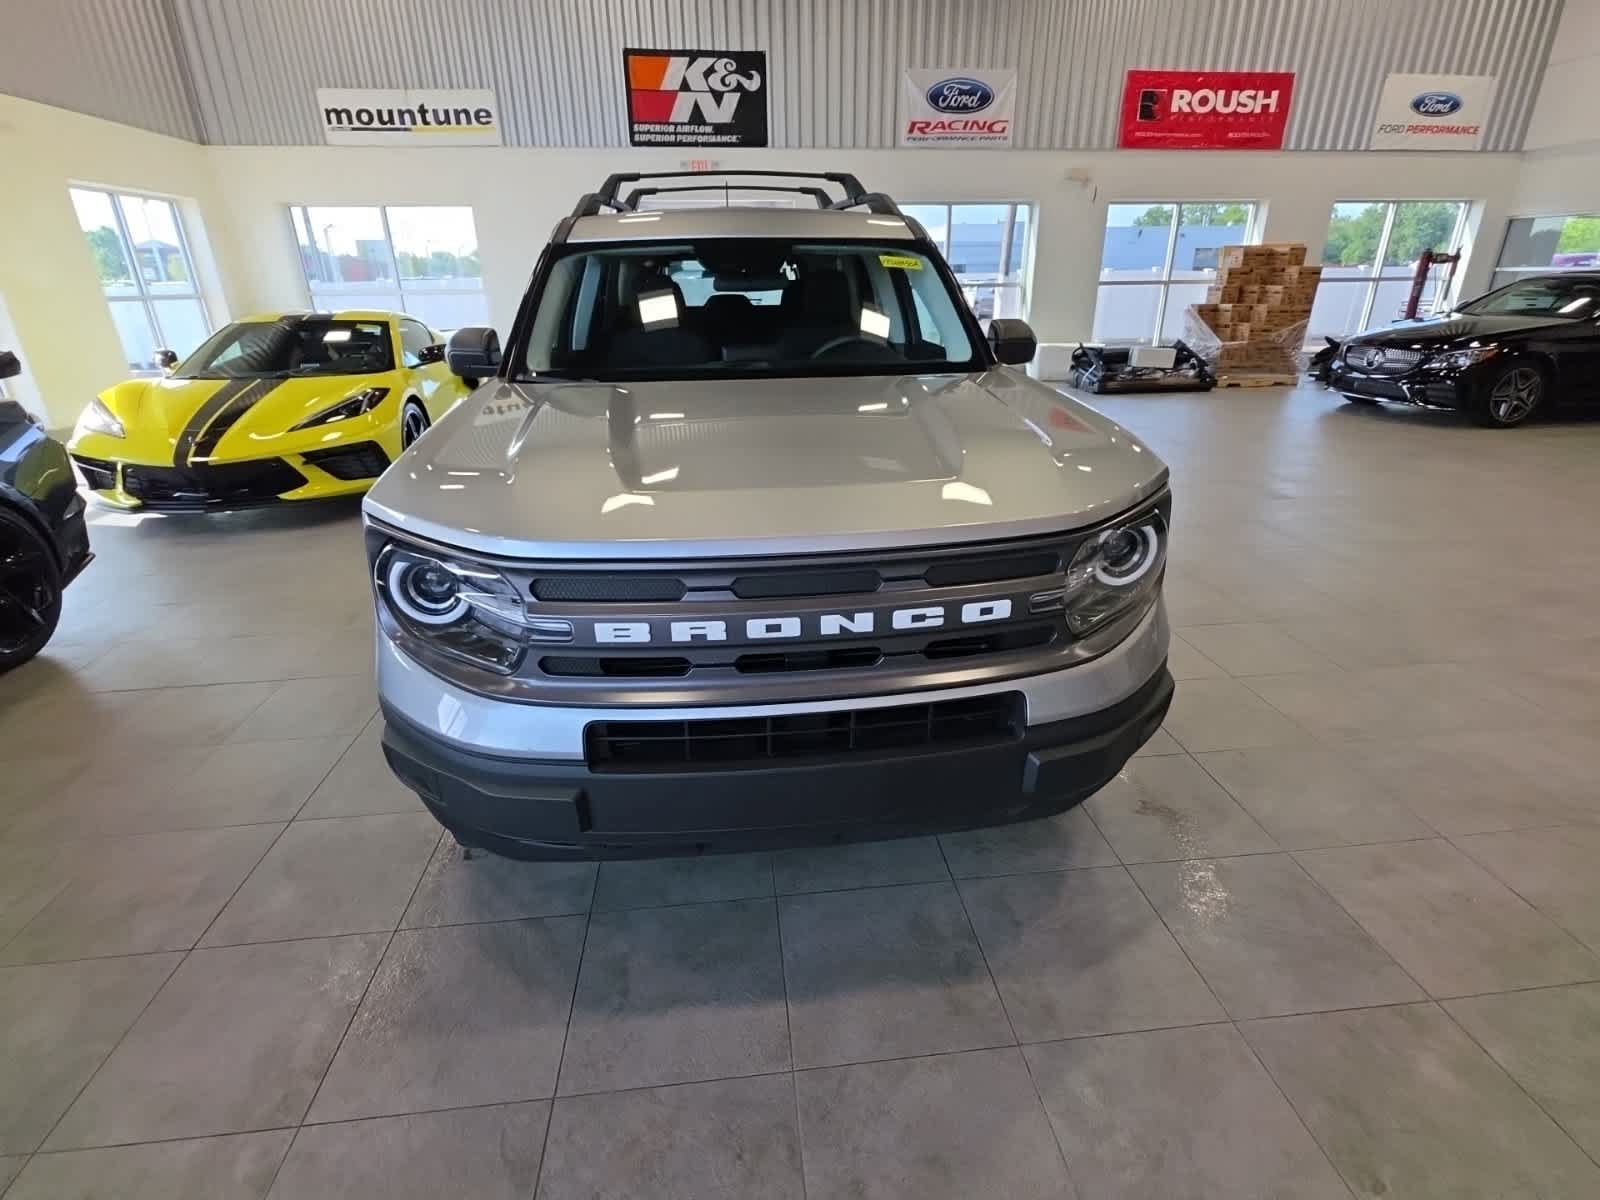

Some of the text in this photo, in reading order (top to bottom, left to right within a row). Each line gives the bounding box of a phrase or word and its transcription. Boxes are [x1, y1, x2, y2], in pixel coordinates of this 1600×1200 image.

[938, 84, 982, 108] Ford
[1170, 89, 1279, 114] ROUSH
[1420, 95, 1454, 113] Ford
[324, 103, 493, 126] mountune
[633, 124, 675, 133] SUPERIOR
[907, 120, 1009, 135] RACING
[1378, 124, 1480, 135] FORD PERFORMANCE
[634, 134, 675, 142] SUPERIOR
[594, 599, 1012, 643] BRONCO
